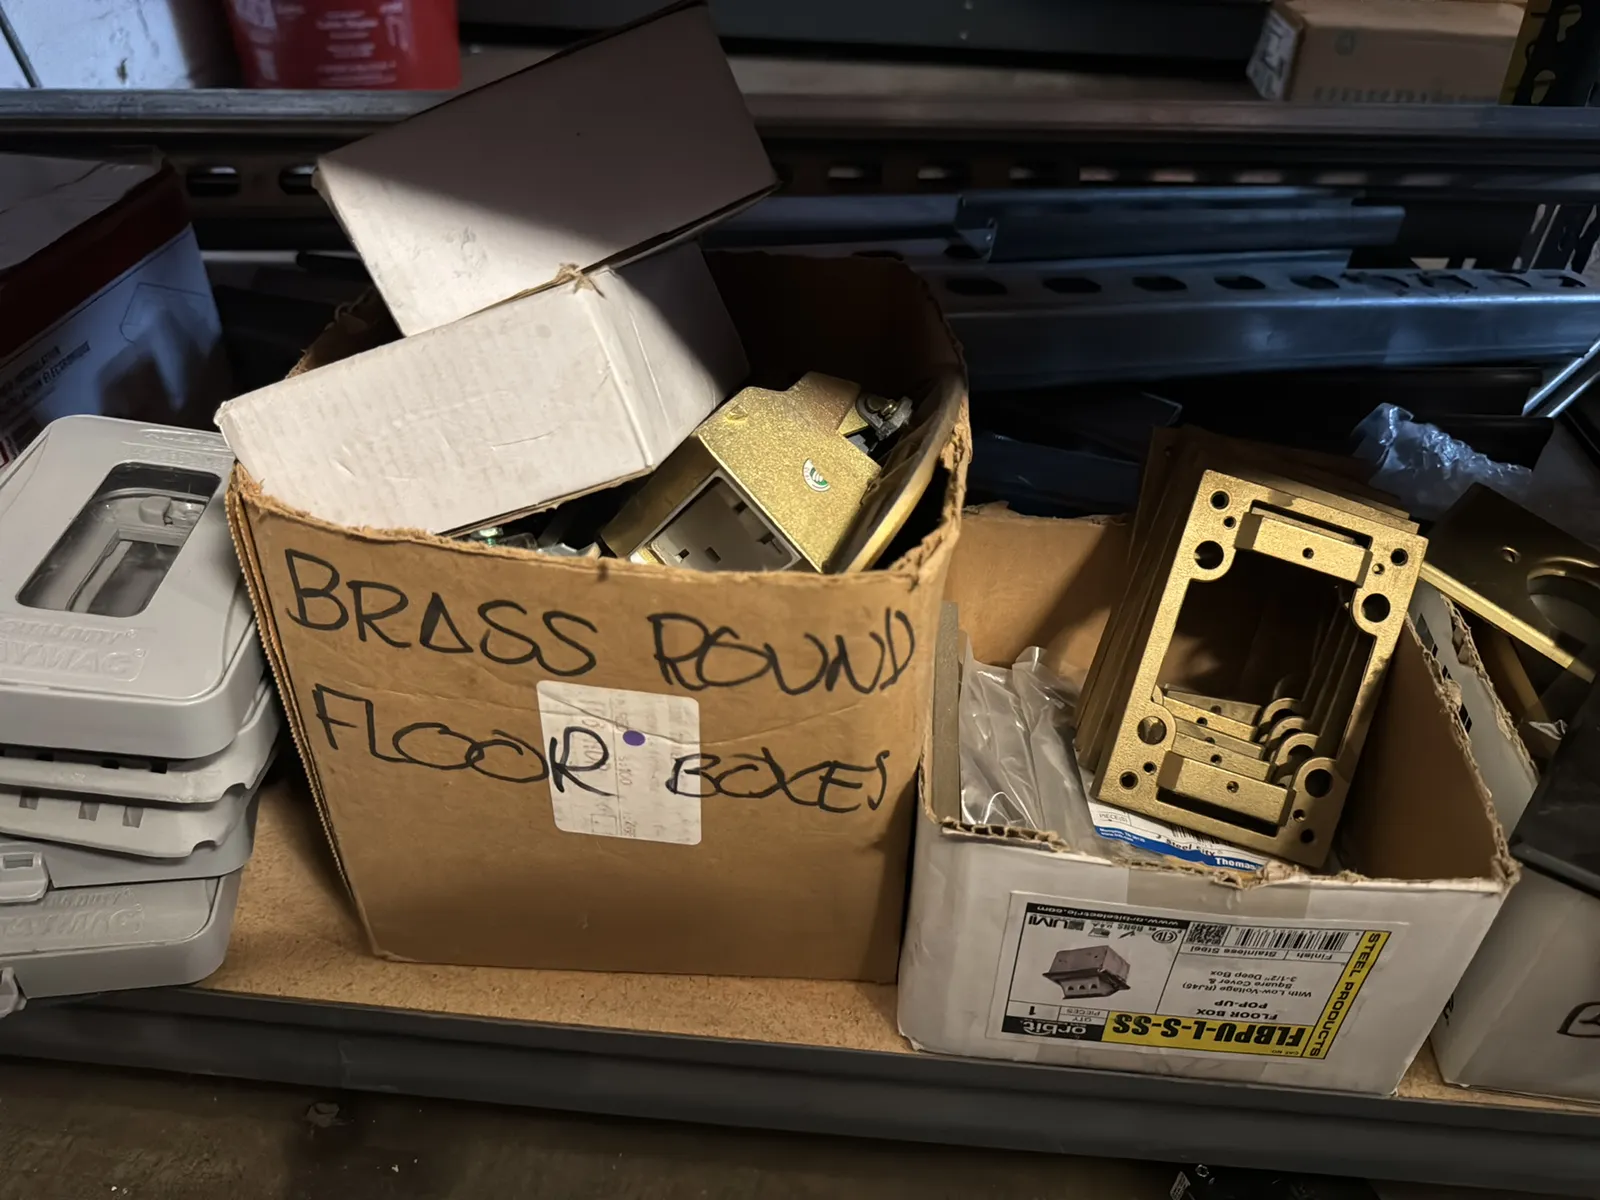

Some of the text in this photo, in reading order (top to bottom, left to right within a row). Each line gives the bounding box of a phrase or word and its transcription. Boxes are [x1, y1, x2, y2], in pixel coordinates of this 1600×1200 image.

[284, 548, 915, 696] BRASS ROUND
[312, 682, 620, 799] FLOOR
[666, 746, 890, 813] BOXES
[1190, 945, 1277, 958] Stainless Steel
[1296, 952, 1333, 960] Finish
[1210, 969, 1232, 978] Box
[1235, 971, 1259, 981] Deep
[1224, 978, 1253, 987] Cover
[1255, 980, 1292, 989] Square
[1182, 981, 1312, 998] With Low-Voltage (RJ45)
[1310, 932, 1382, 1057] STEEL PRODUCTS
[1028, 1005, 1036, 1016] 1
[1214, 999, 1269, 1010] POP-UP
[1195, 1007, 1278, 1020] FLOOR BOX
[1022, 1020, 1087, 1036] orbit
[1112, 1013, 1307, 1047] FLBPU-L-S-SS
